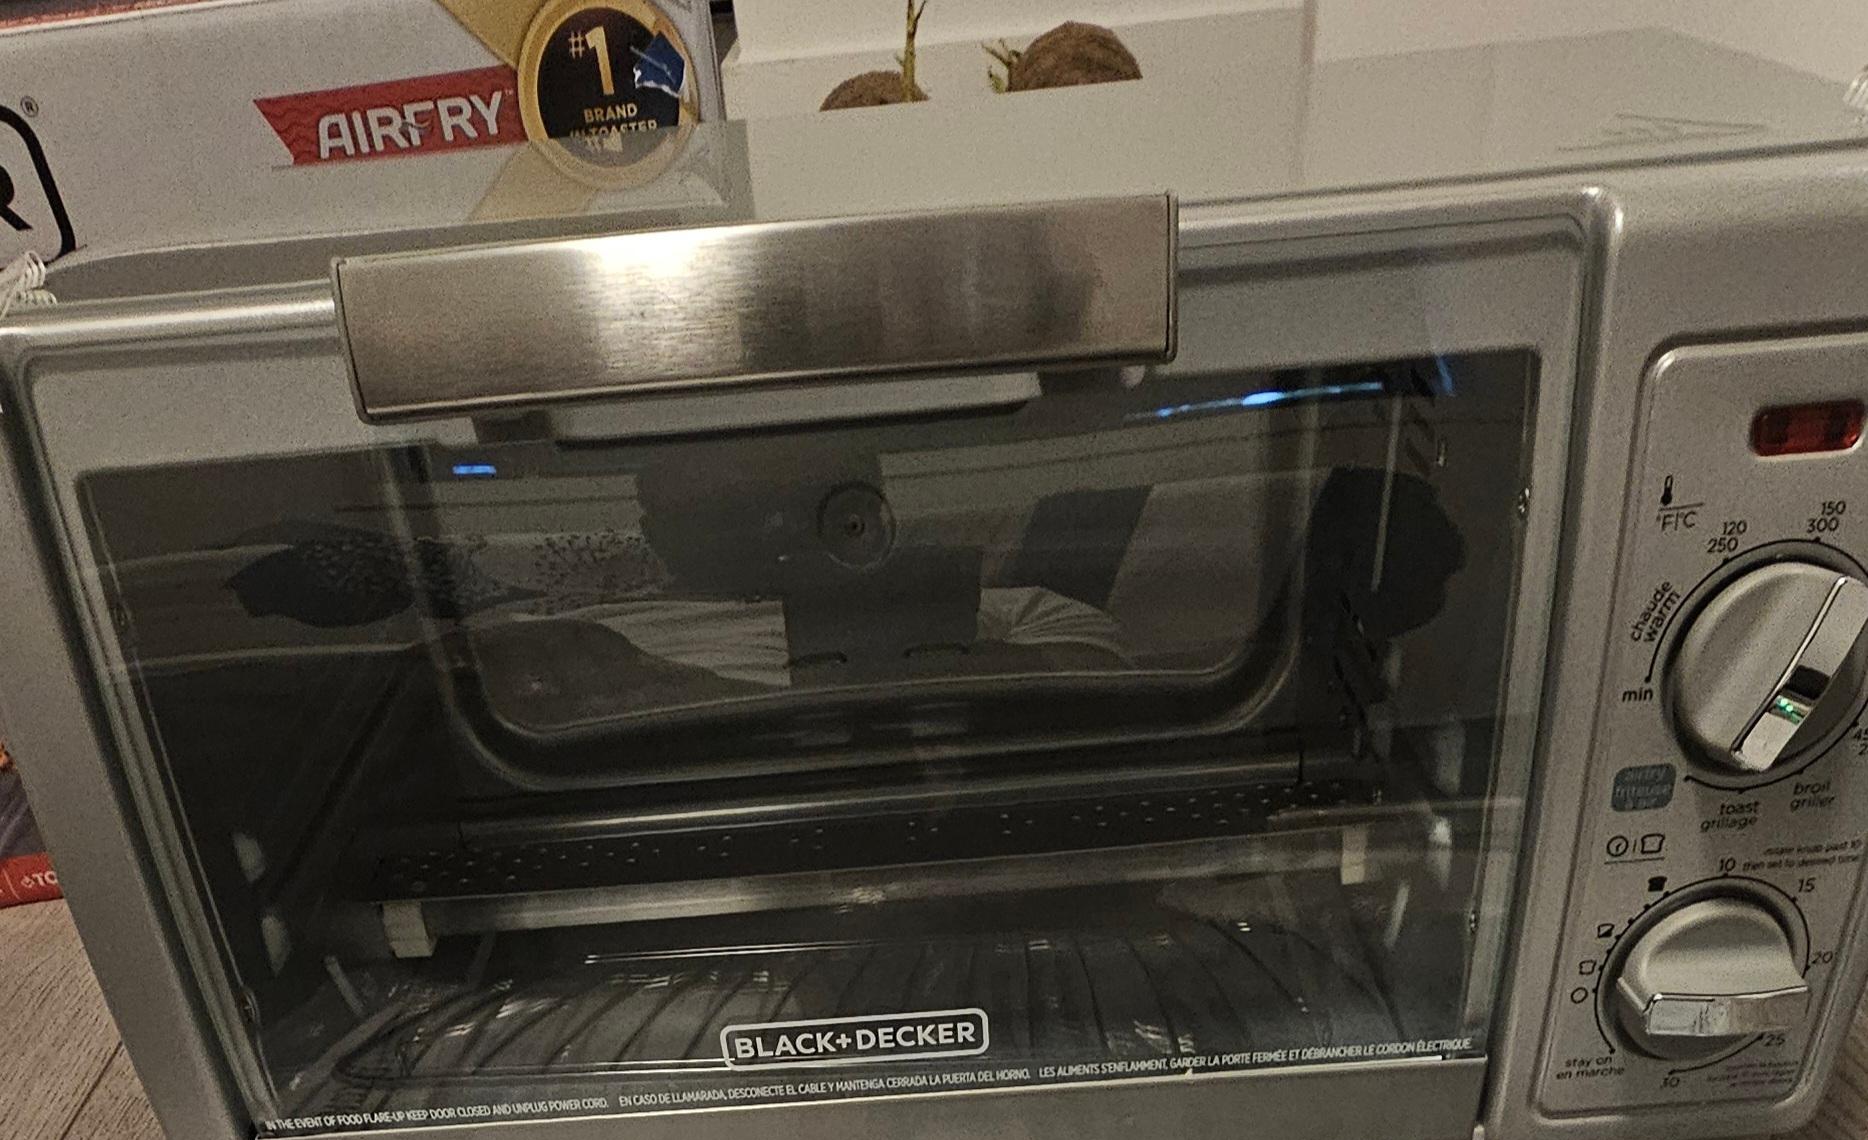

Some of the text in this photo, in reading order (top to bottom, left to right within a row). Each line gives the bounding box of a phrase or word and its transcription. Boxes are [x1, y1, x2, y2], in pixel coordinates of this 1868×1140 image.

[568, 26, 615, 96] #1
[583, 103, 638, 123] BRAND
[318, 91, 502, 159] AIRFRY
[1820, 501, 1847, 517] 150
[1722, 519, 1748, 536] 120
[1806, 518, 1840, 534] 300
[1706, 537, 1739, 554] 250
[1630, 580, 1674, 643] chaude
[1643, 590, 1683, 644] warm
[1622, 687, 1654, 702] min
[1793, 780, 1831, 796] broil
[1719, 801, 1760, 816] toast
[1700, 816, 1758, 833] grillage
[1719, 857, 1737, 873] 10
[1798, 877, 1817, 893] 15
[734, 1022, 976, 1058] BLACK+DECKER
[1039, 1066, 1056, 1078] LES
[1057, 1062, 1100, 1076] ALIMENTS
[1170, 1055, 1206, 1069] GARDER
[1207, 1054, 1220, 1066] LA
[1221, 1052, 1250, 1065] PORTE
[1288, 1050, 1300, 1061] ET
[1363, 1045, 1375, 1056] LE
[1376, 1041, 1415, 1055] CORDON
[619, 1095, 632, 1107] EN
[633, 1093, 657, 1105] CASO
[659, 1092, 671, 1104] DE
[728, 1085, 785, 1099] DESCONECTE
[786, 1084, 797, 1095] EL
[798, 1081, 827, 1094] CABLE
[835, 1078, 885, 1092] MANTENGA
[886, 1075, 928, 1088] CERRADA
[929, 1074, 941, 1085] LA
[942, 1071, 976, 1084] PUERTA
[977, 1070, 995, 1082] DEL
[276, 1118, 295, 1129] THE
[295, 1116, 323, 1129] EVENT
[324, 1115, 337, 1126] OF
[337, 1113, 363, 1126] FOOD
[406, 1109, 429, 1121] KEEP
[430, 1107, 456, 1120] DOOR
[456, 1104, 491, 1118] CLOSED
[492, 1103, 511, 1115] AND
[512, 1100, 548, 1114] UNPLUG
[549, 1098, 581, 1111] POWER
